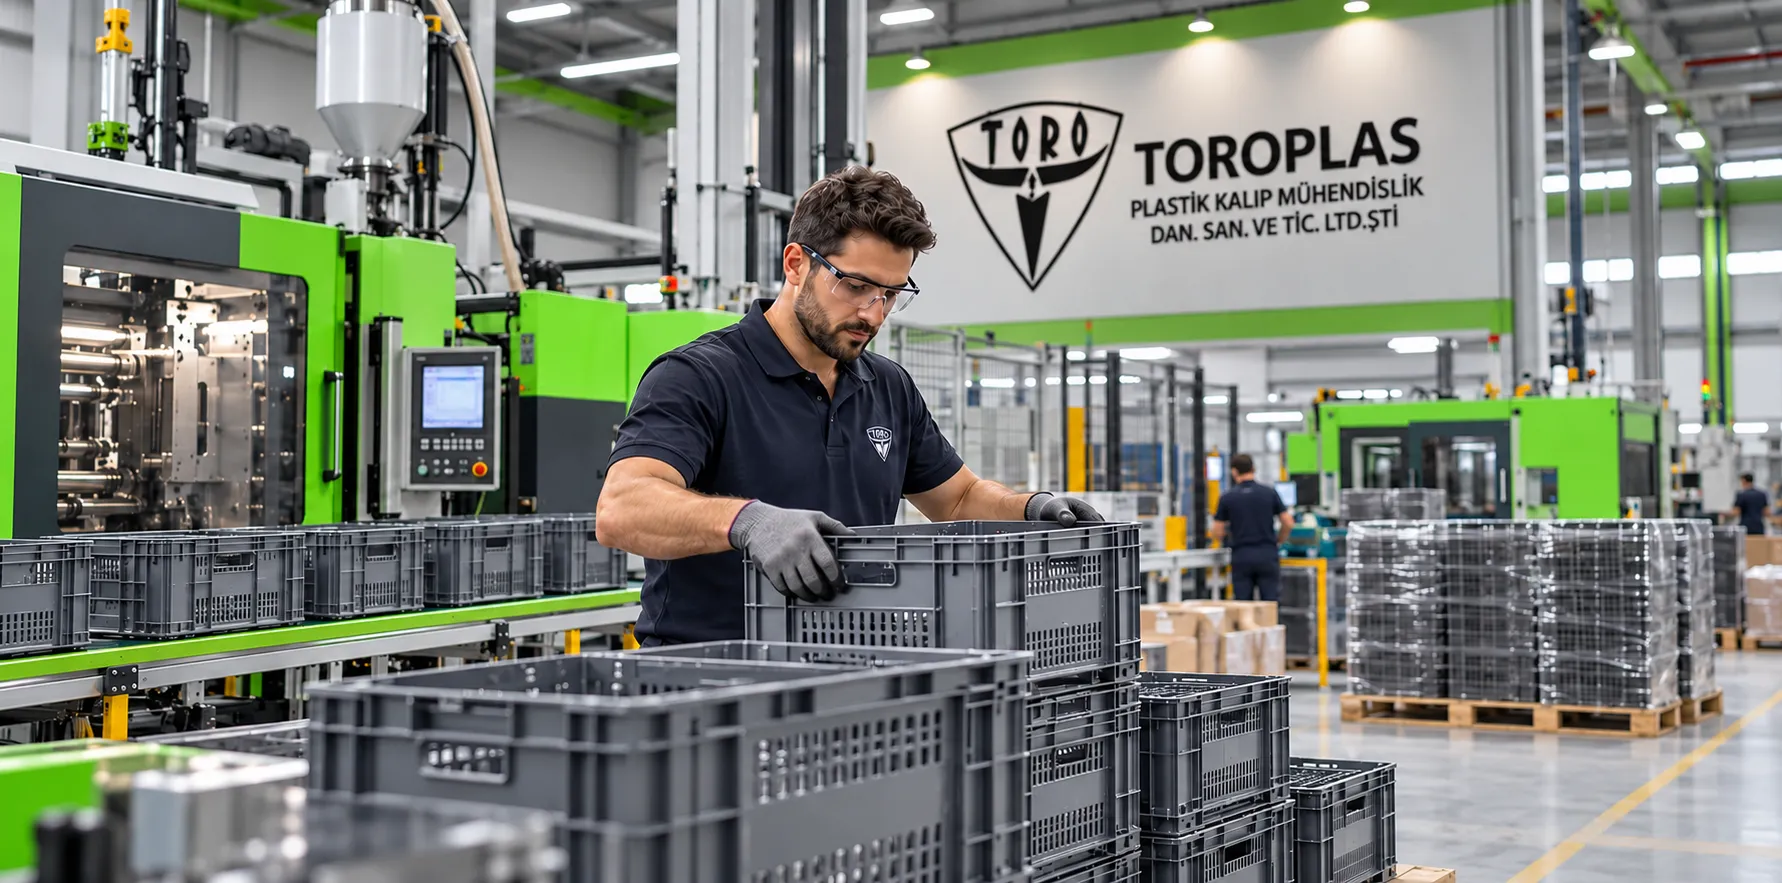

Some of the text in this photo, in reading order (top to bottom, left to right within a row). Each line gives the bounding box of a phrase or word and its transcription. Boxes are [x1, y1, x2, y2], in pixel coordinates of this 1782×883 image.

[980, 110, 1089, 166] TORO
[1133, 116, 1421, 186] TOROPLAS
[1131, 174, 1425, 219] PLASTİK KALIP MÜHENDİSLİK
[1151, 203, 1398, 245] DAN. SAN. VE TİC. LTD.ŞTİ
